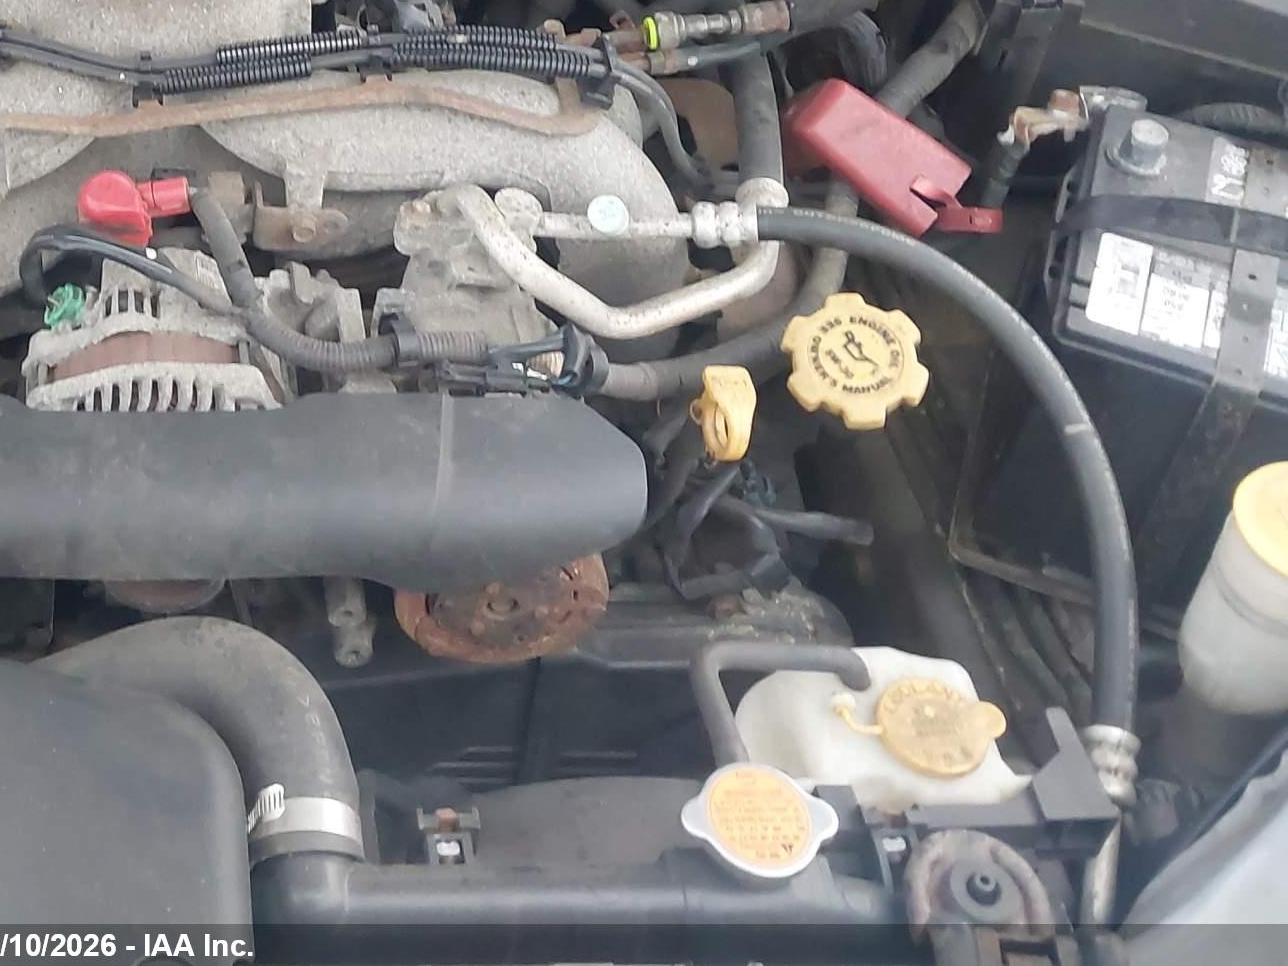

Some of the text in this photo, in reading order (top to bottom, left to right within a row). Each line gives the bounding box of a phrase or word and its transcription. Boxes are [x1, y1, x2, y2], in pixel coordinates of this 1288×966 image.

[820, 316, 901, 369] SEE ENGINE OIL
